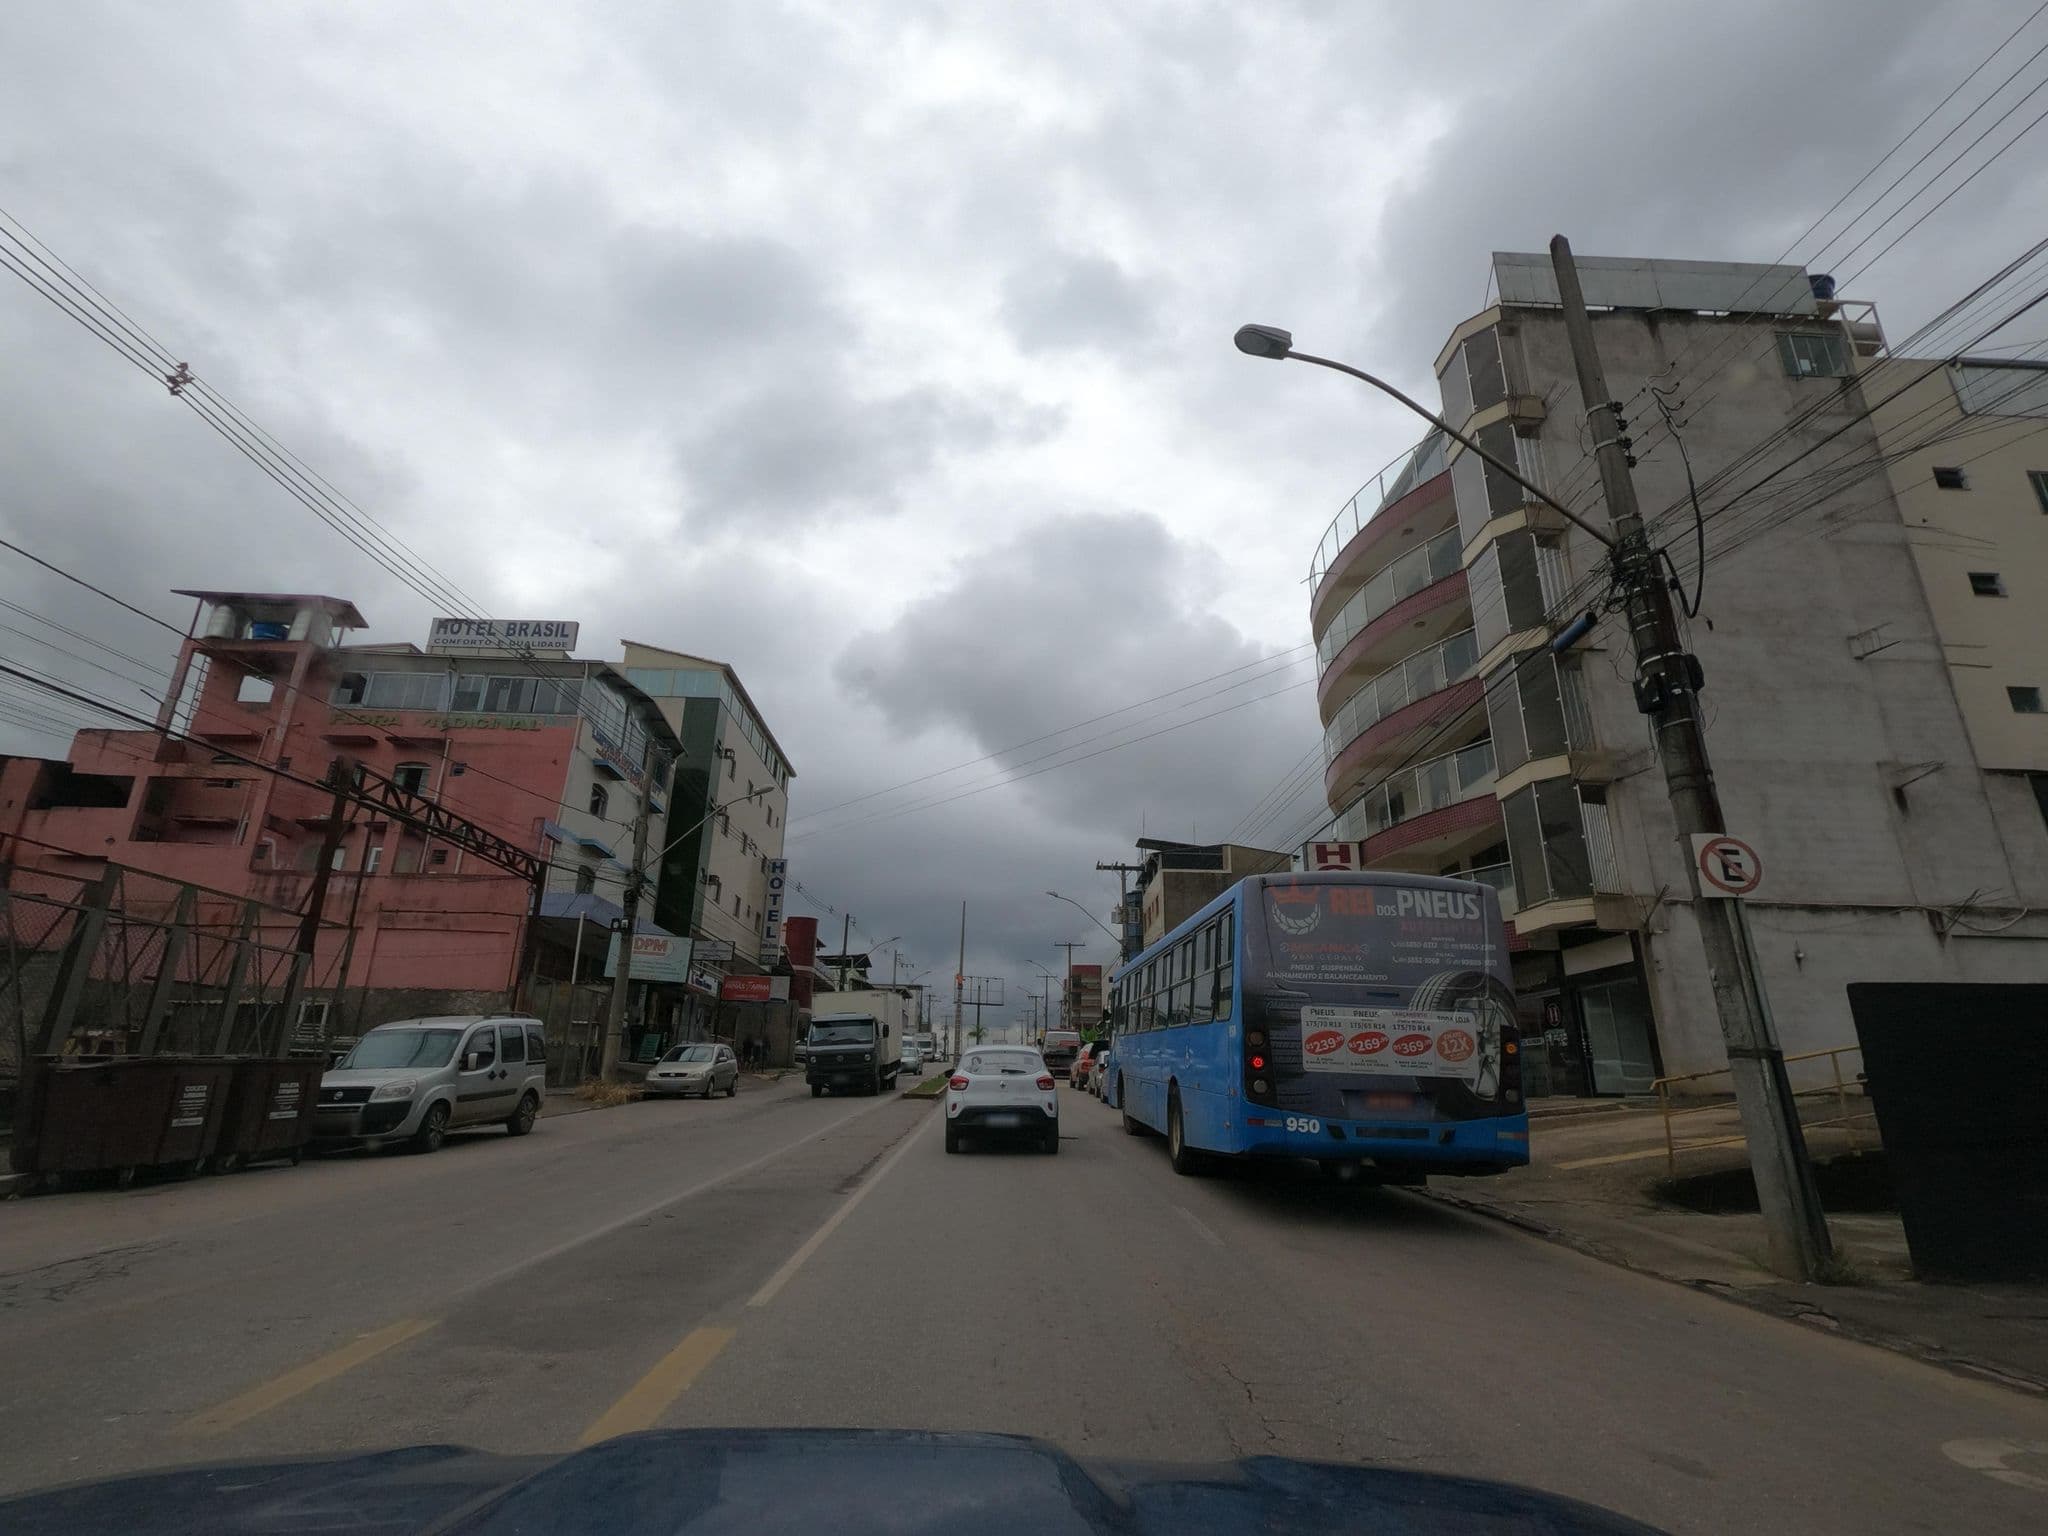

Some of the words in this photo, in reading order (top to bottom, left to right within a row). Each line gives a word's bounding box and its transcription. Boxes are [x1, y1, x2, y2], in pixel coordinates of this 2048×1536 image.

[435, 619, 497, 637] HOTEL
[504, 621, 570, 639] BRASIL
[433, 638, 492, 647] CONFORTO
[509, 640, 568, 649] QUALIDADE
[765, 861, 785, 939] HOTEL
[1376, 903, 1397, 917] DOS
[1396, 889, 1481, 921] PNEUS
[1310, 1008, 1336, 1016] PNEUS
[1352, 1010, 1380, 1018] PNEUS
[1286, 1117, 1321, 1134] 950
